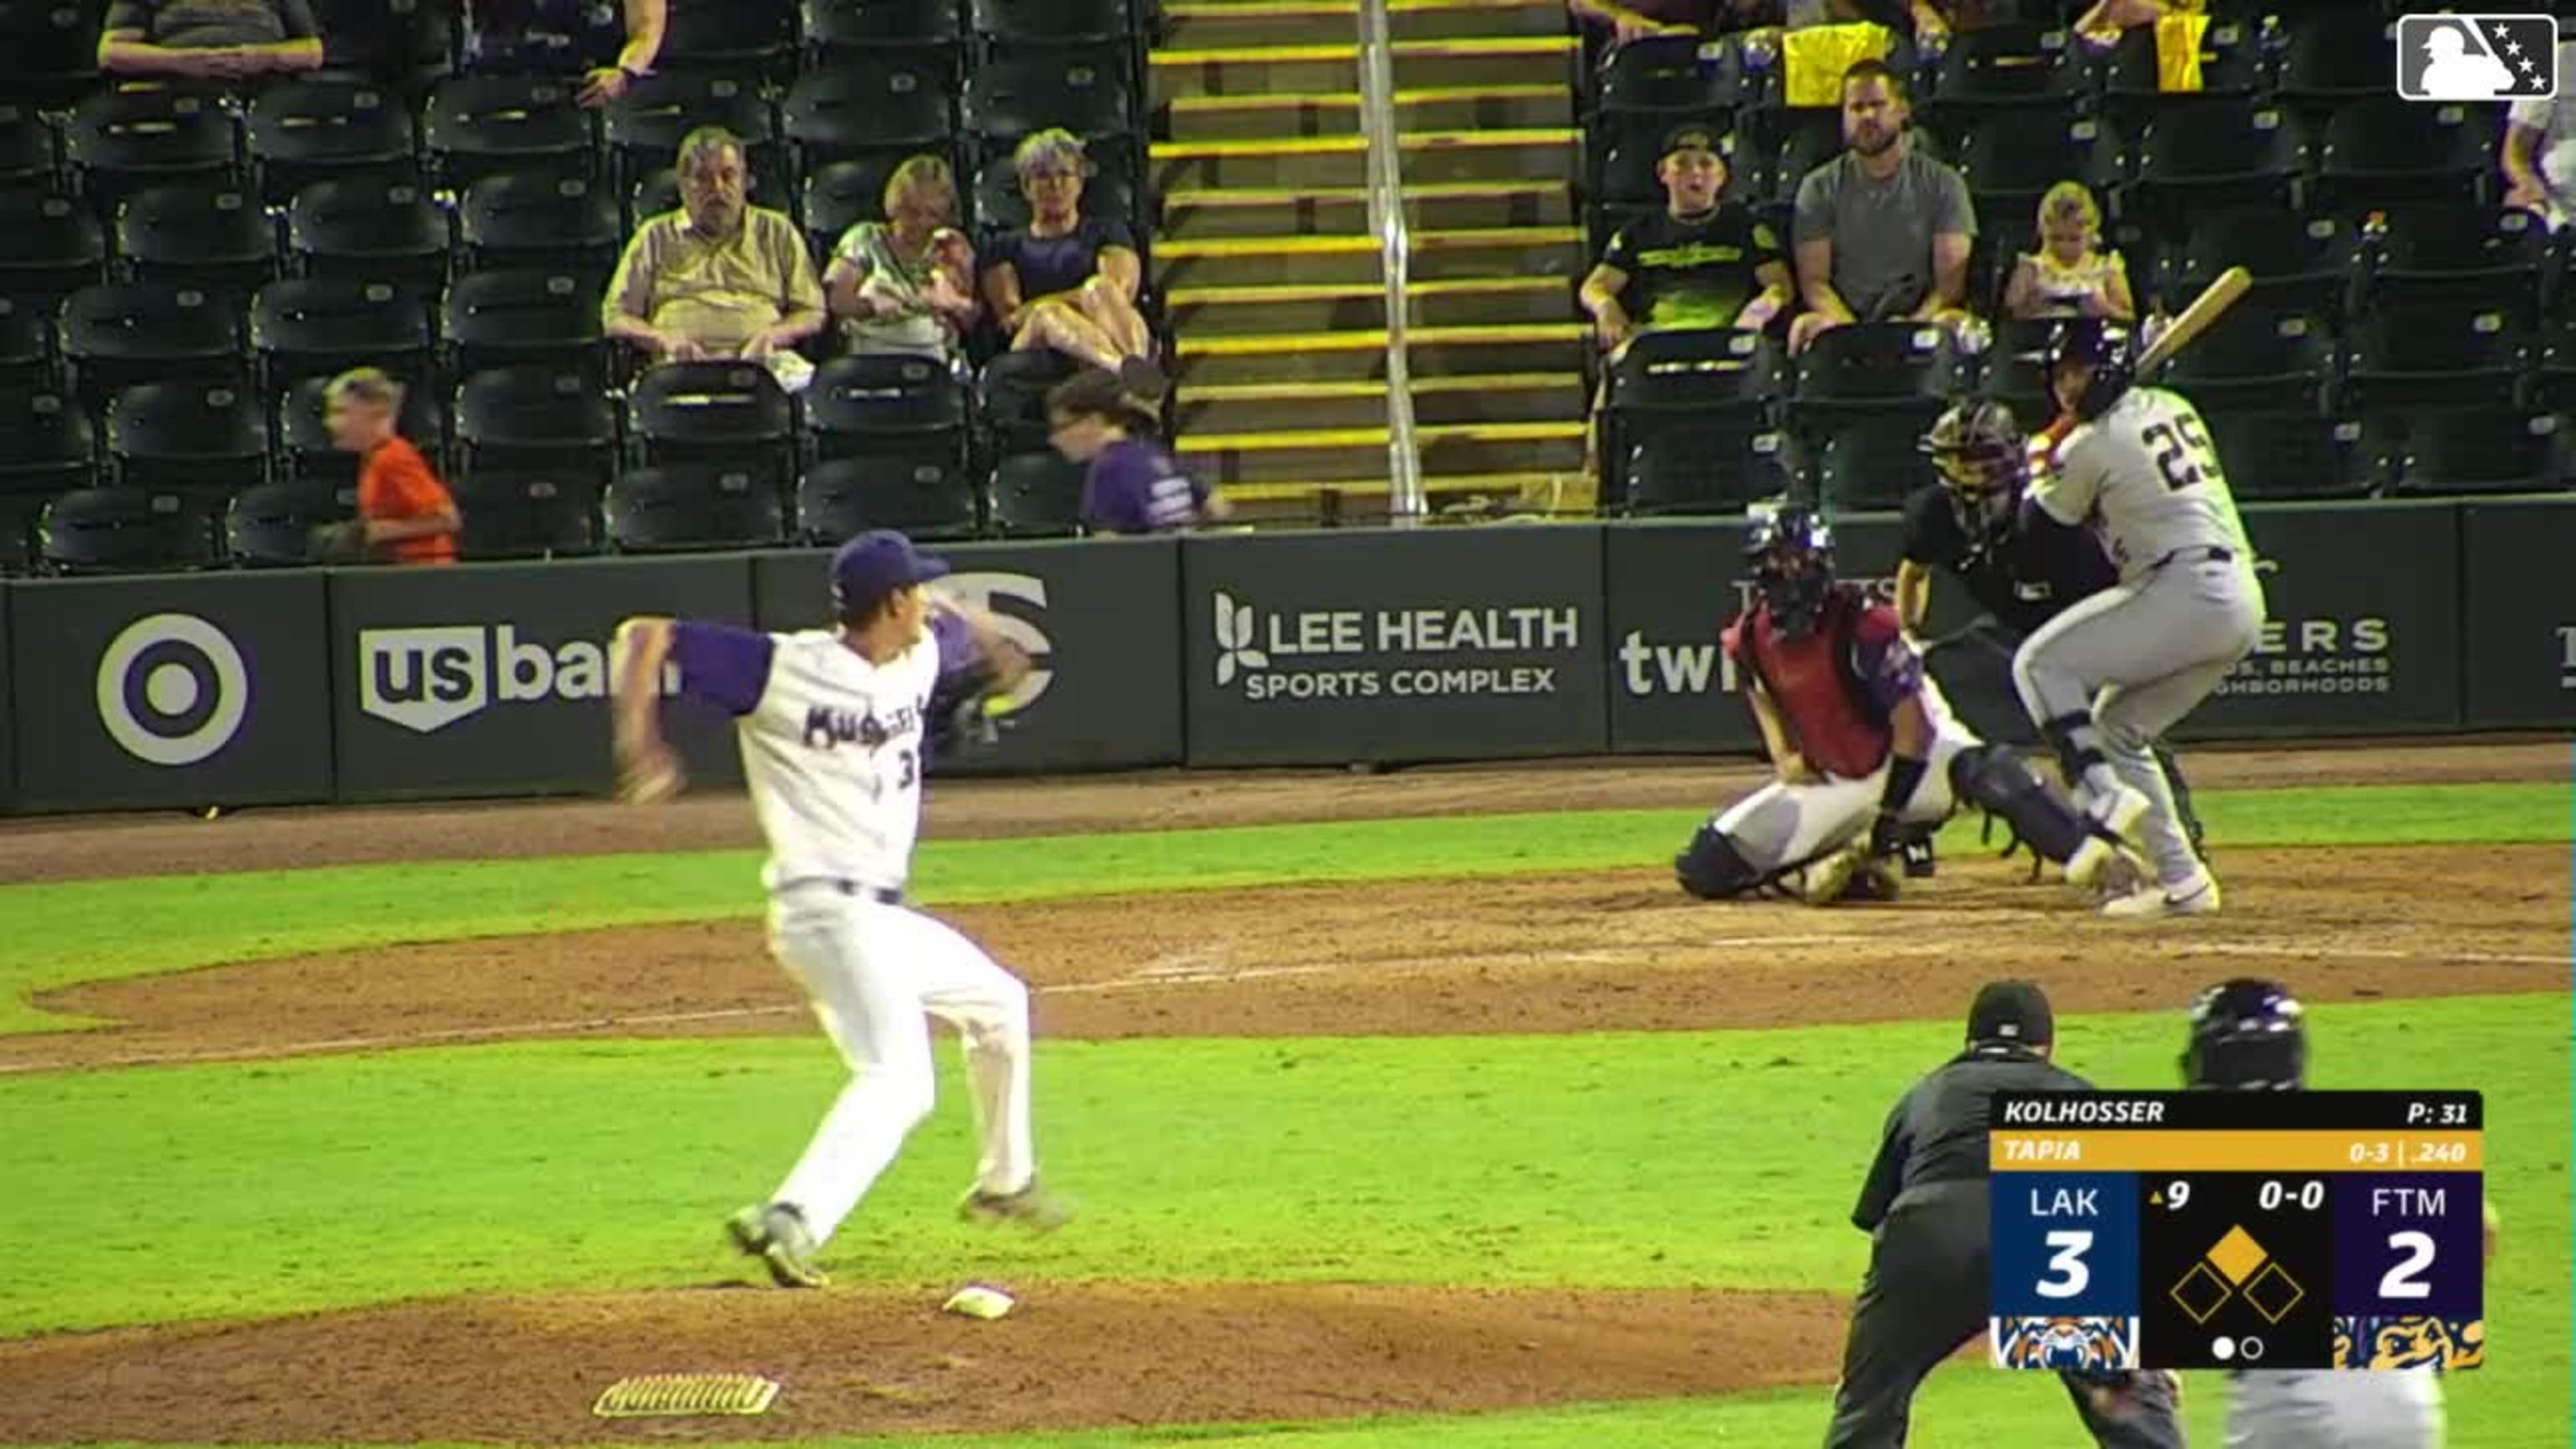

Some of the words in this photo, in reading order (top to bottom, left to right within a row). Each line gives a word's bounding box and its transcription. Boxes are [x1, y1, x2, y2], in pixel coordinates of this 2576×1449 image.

[2142, 413, 2220, 491] 25
[1269, 611, 1363, 654] LEE
[1378, 607, 1578, 652] HEALTH
[2254, 618, 2388, 652] ERS
[374, 647, 472, 703] us
[1246, 672, 1380, 699] SPORTS
[1389, 667, 1555, 695] COMPLEX
[2269, 657, 2389, 675] BEACHES
[2215, 677, 2389, 695] GHBORHOODS
